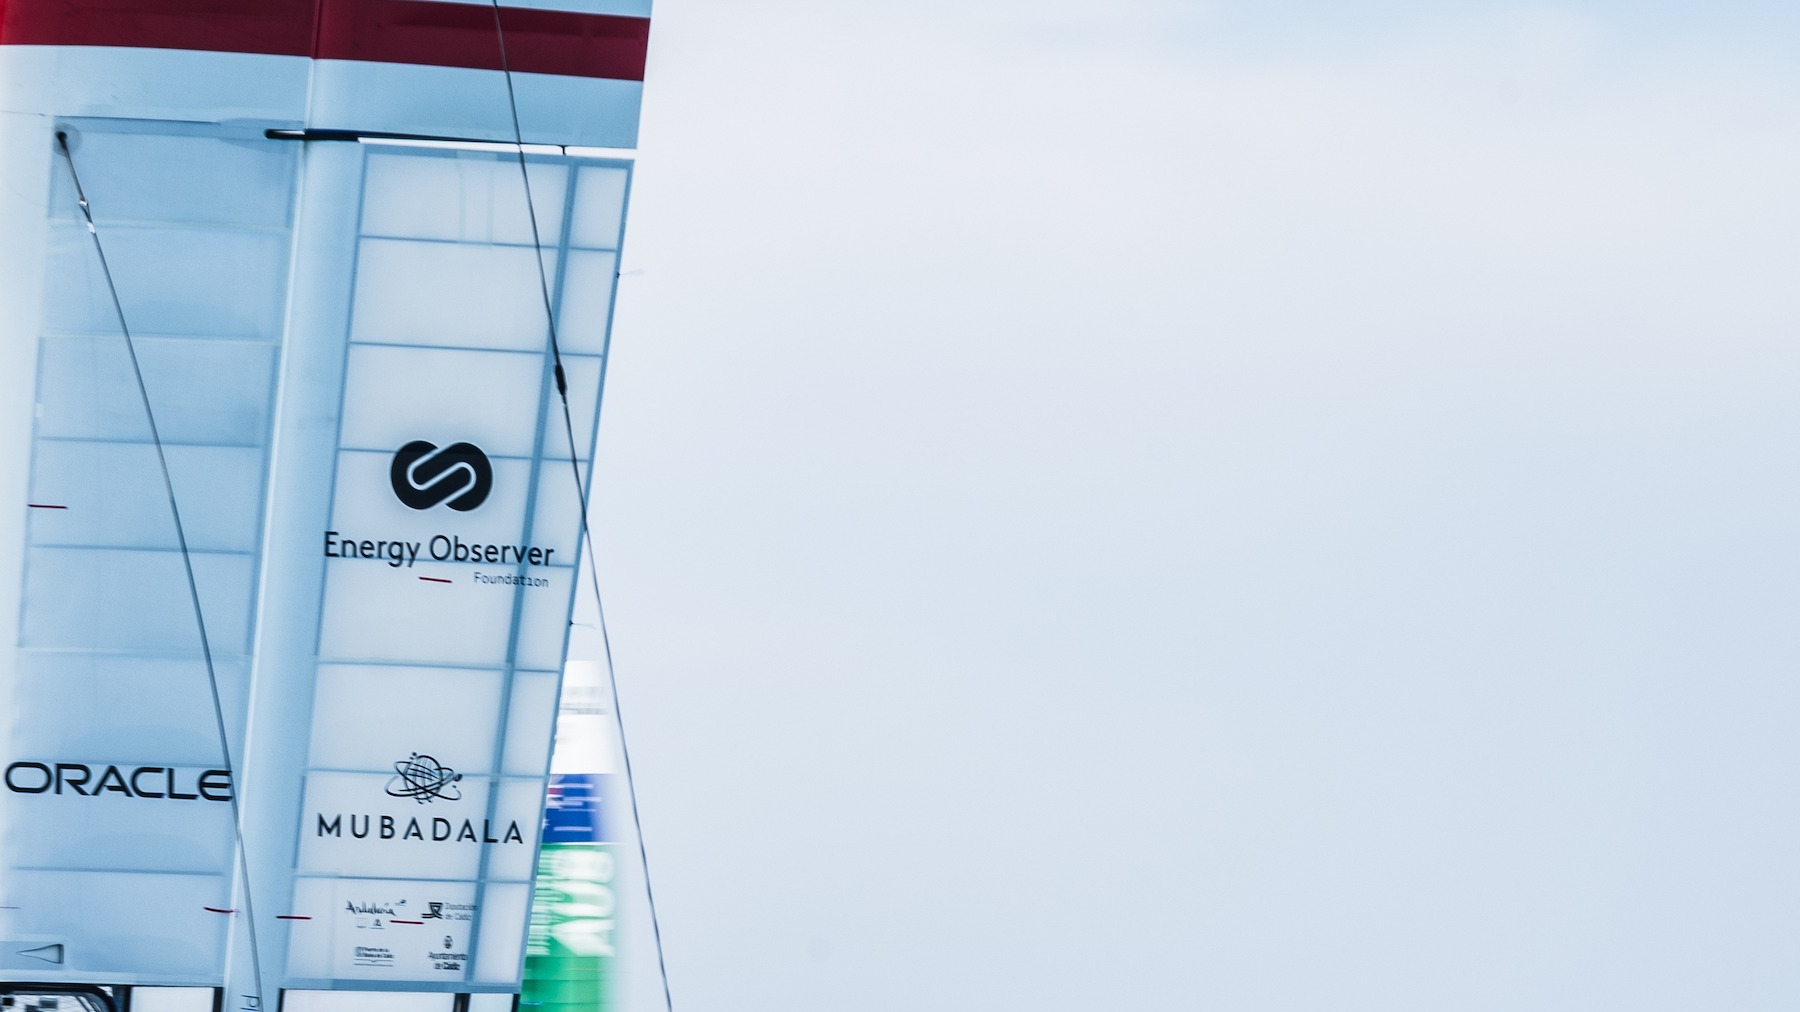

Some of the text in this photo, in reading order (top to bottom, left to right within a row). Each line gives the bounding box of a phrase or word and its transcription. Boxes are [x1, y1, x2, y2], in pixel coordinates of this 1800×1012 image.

[324, 531, 555, 568] Energy Observer
[473, 571, 550, 588] Foundation
[4, 761, 234, 802] ORACLE
[317, 812, 524, 845] MUBADALA
